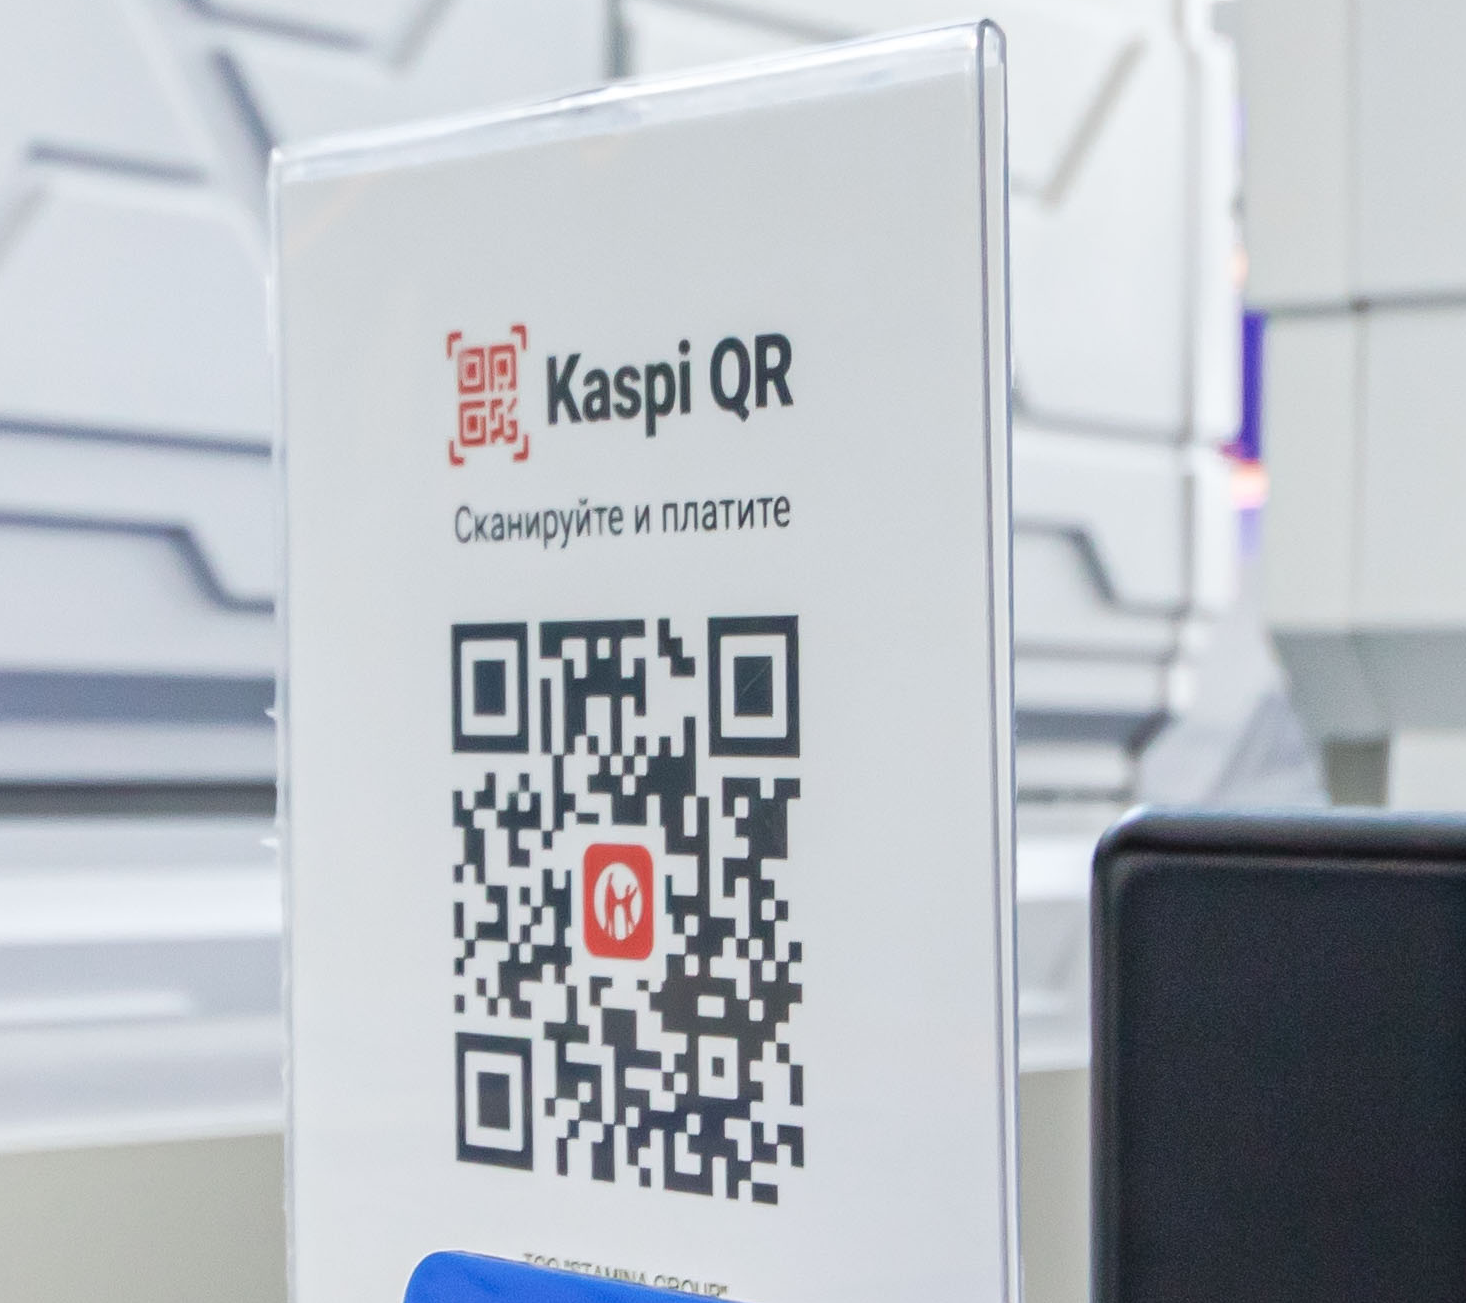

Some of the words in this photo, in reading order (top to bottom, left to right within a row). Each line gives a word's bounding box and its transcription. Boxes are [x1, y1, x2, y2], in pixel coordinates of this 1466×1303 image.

[546, 339, 691, 438] Kaspi
[710, 333, 794, 422] QR
[455, 499, 624, 548] Сканируйте
[635, 503, 650, 535] и
[662, 496, 790, 533] платите
